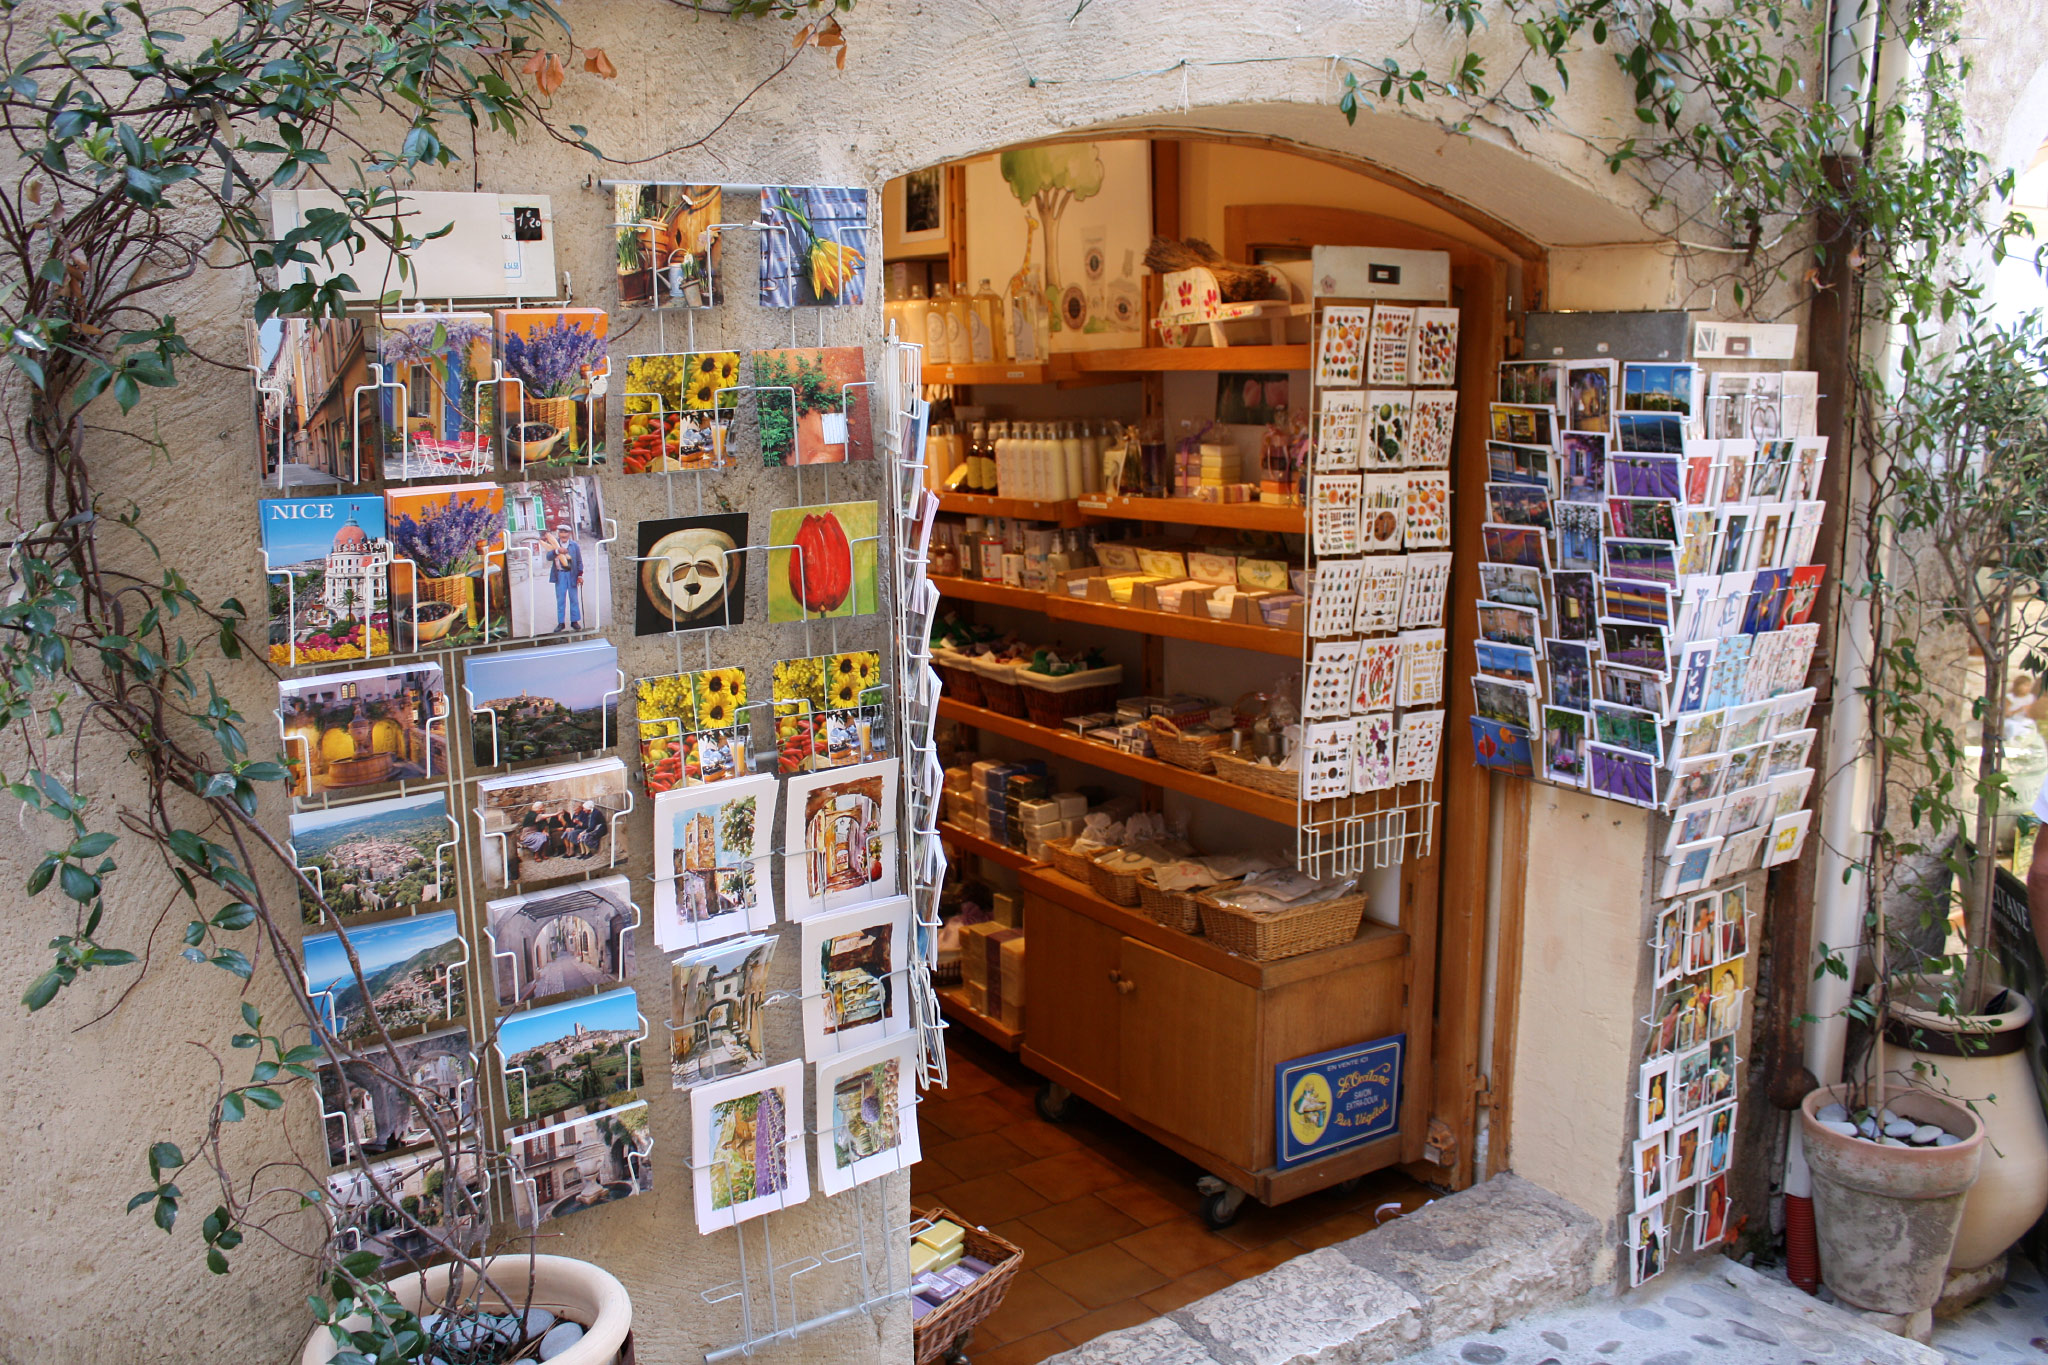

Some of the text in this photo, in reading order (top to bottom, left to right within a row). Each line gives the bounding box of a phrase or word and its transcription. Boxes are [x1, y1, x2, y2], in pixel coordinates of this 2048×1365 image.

[271, 503, 335, 520] NICE
[1338, 1060, 1359, 1069] VENTE
[1354, 1088, 1372, 1099] SAVON
[1333, 1112, 1352, 1127] Pur
